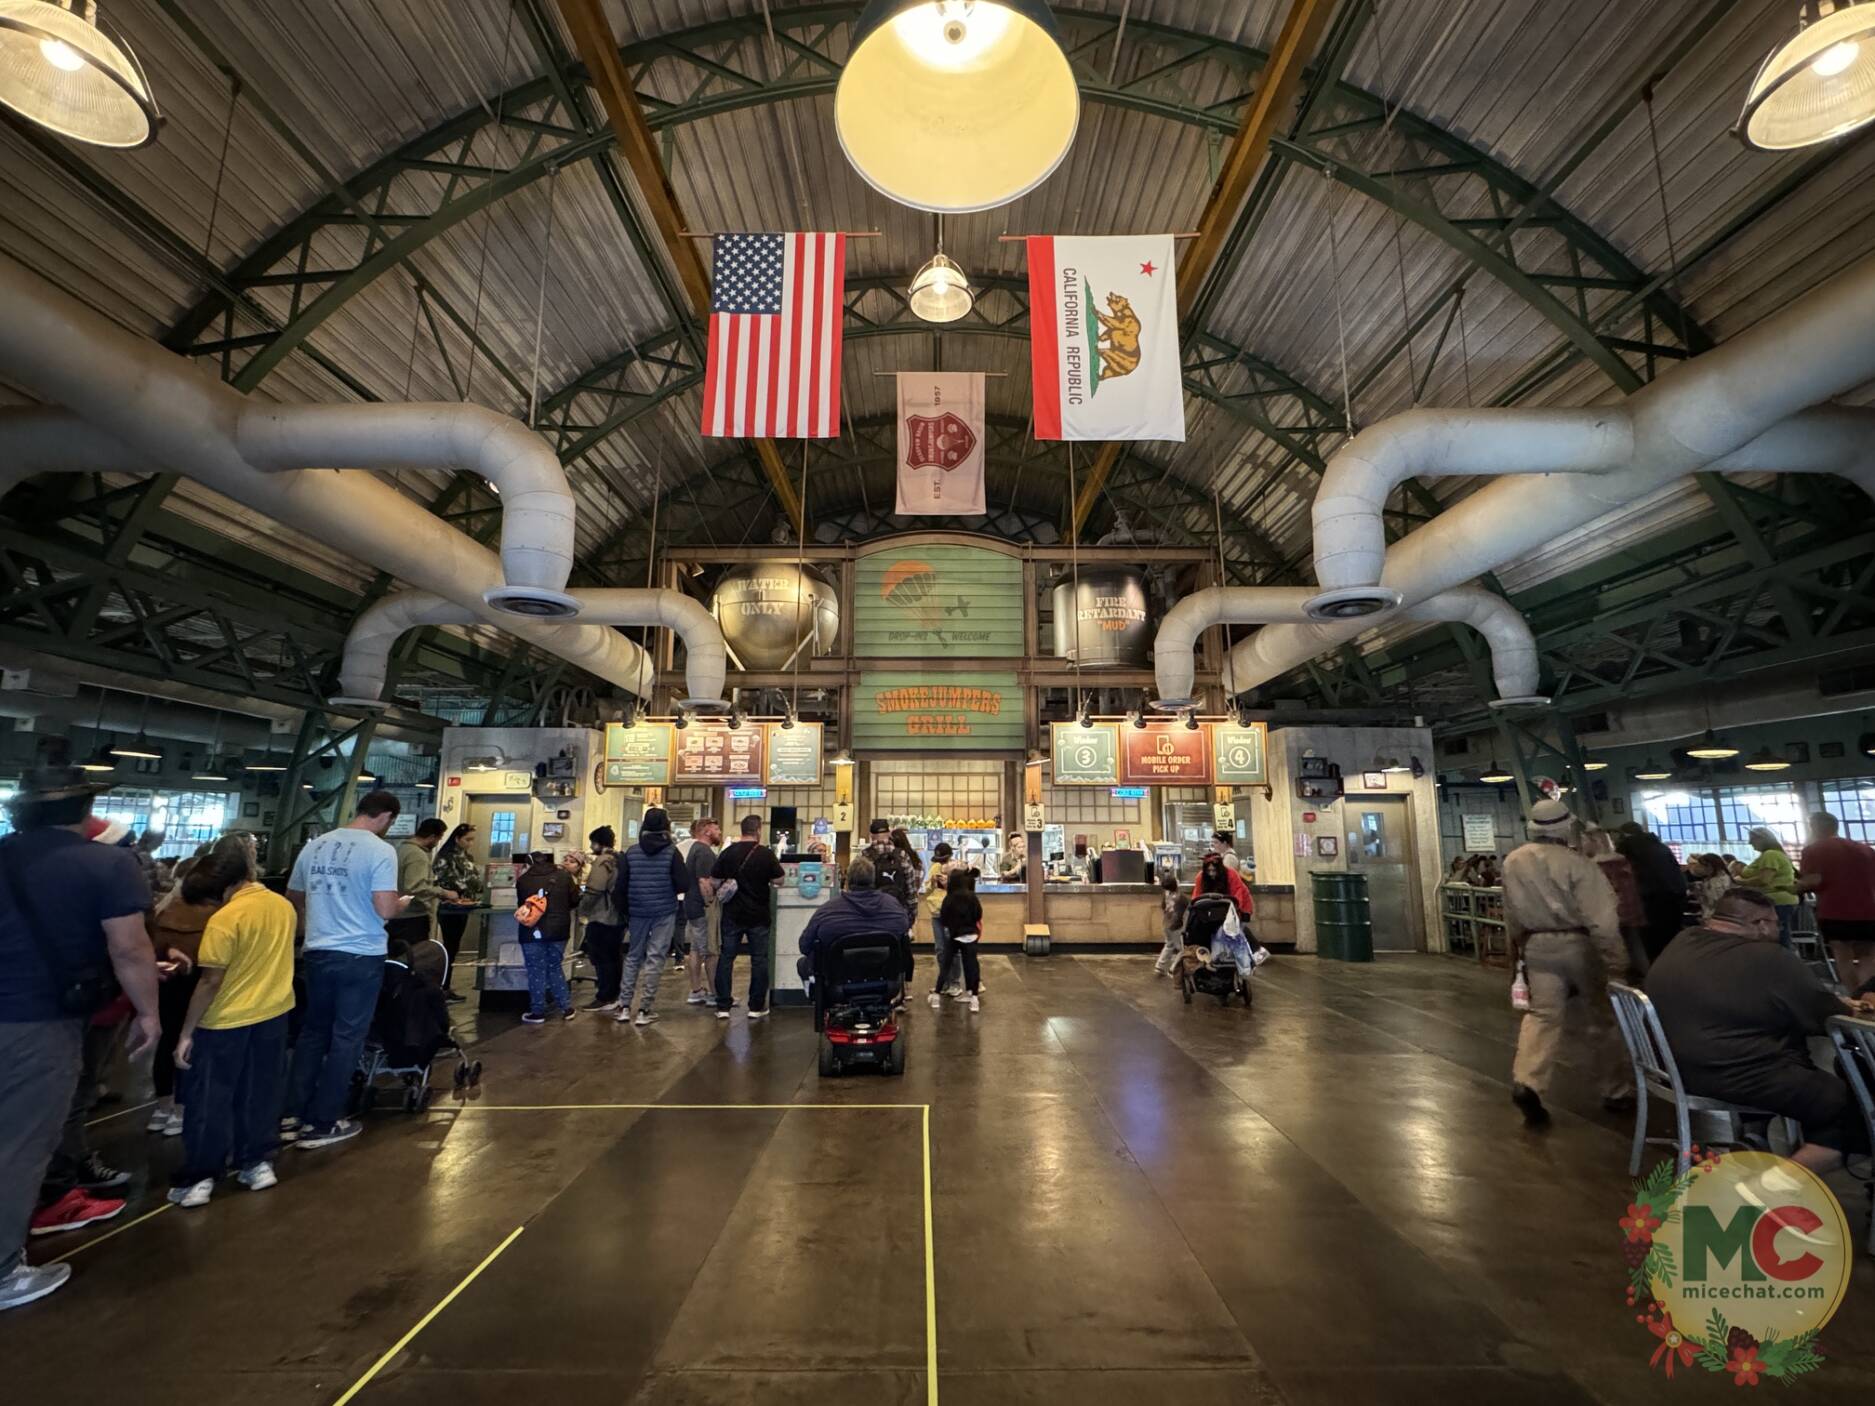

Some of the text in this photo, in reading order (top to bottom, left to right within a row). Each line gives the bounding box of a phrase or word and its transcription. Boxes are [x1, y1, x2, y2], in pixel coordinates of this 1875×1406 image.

[1063, 267, 1083, 405] CALIFORNIA REPUBLIC
[737, 578, 789, 591] WATER
[1095, 596, 1127, 608] FIRE
[741, 602, 785, 616] ONLY
[1077, 607, 1146, 622] RETARDANT
[951, 631, 992, 641] WELCOME
[875, 685, 1002, 716] SMOKEJUMPERS
[906, 714, 972, 736] GRILL
[1081, 749, 1091, 765] 3
[1141, 755, 1191, 765] MOBILE ORDER
[1234, 749, 1245, 765] 4
[1152, 764, 1180, 774] PICK UP
[840, 811, 847, 822] 2
[1036, 818, 1043, 829] 3
[1227, 818, 1234, 829] 4
